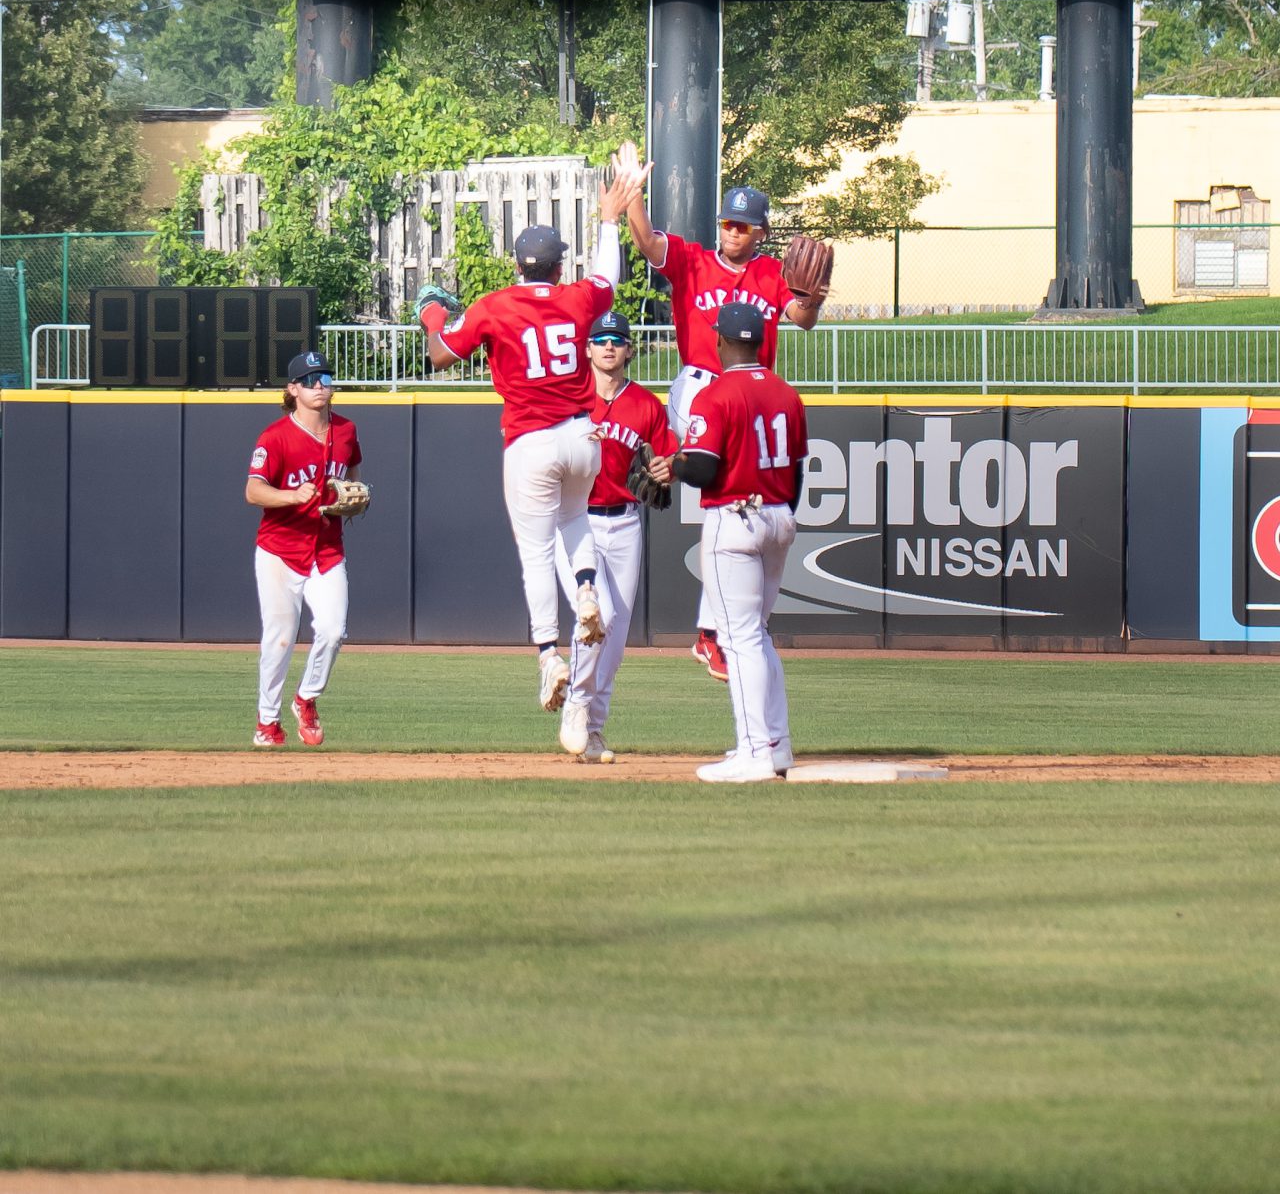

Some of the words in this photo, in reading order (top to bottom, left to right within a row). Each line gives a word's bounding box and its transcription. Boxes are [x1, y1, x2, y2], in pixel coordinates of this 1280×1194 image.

[520, 322, 578, 380] 15
[753, 412, 791, 470] 11
[681, 417, 1079, 527] entor
[896, 537, 1068, 578] NISSAN
